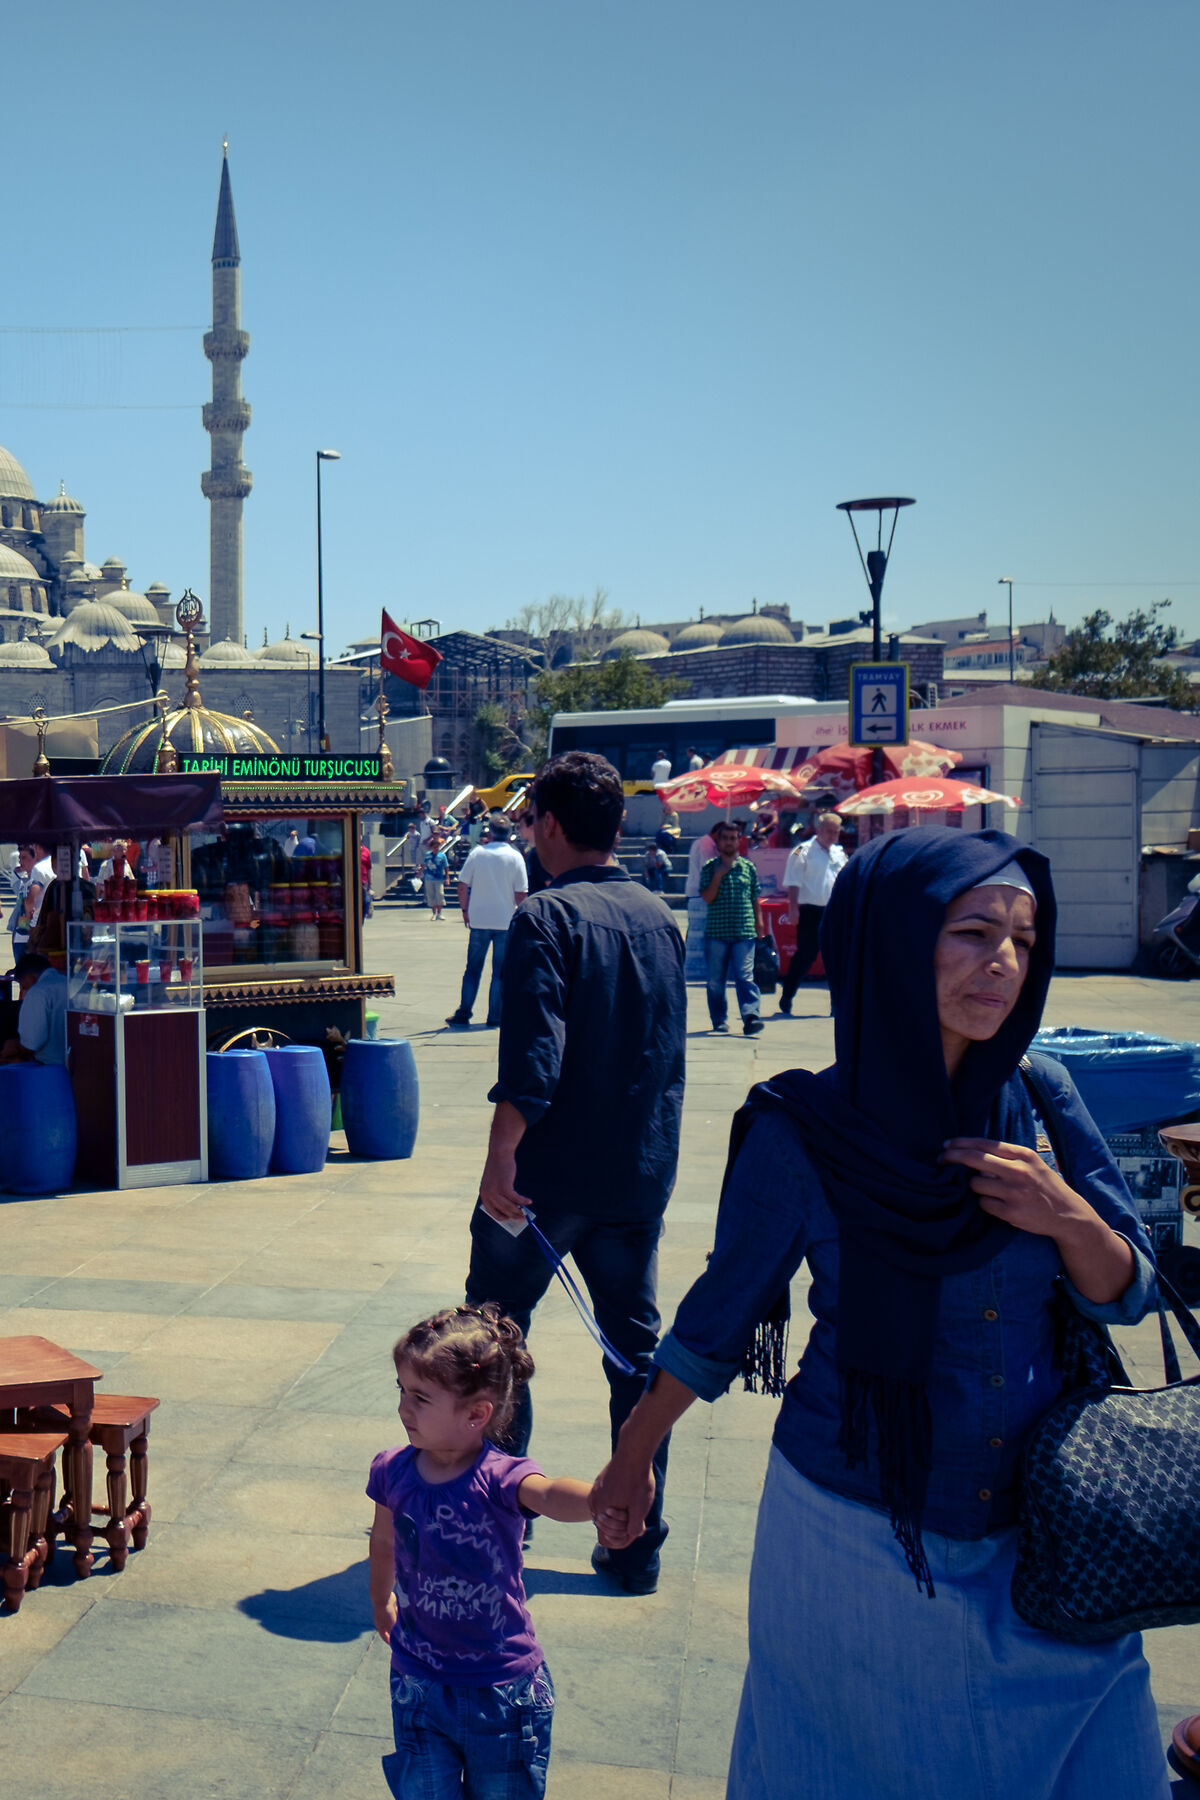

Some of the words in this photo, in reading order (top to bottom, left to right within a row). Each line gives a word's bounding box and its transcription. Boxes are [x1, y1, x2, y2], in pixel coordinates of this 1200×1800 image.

[857, 673, 901, 682] TRAMVAY
[928, 720, 968, 732] EKMEK
[183, 756, 228, 776] TARİHİ
[232, 756, 301, 777] EMİNÖNÜ
[304, 759, 380, 779] TURŞUCUSU
